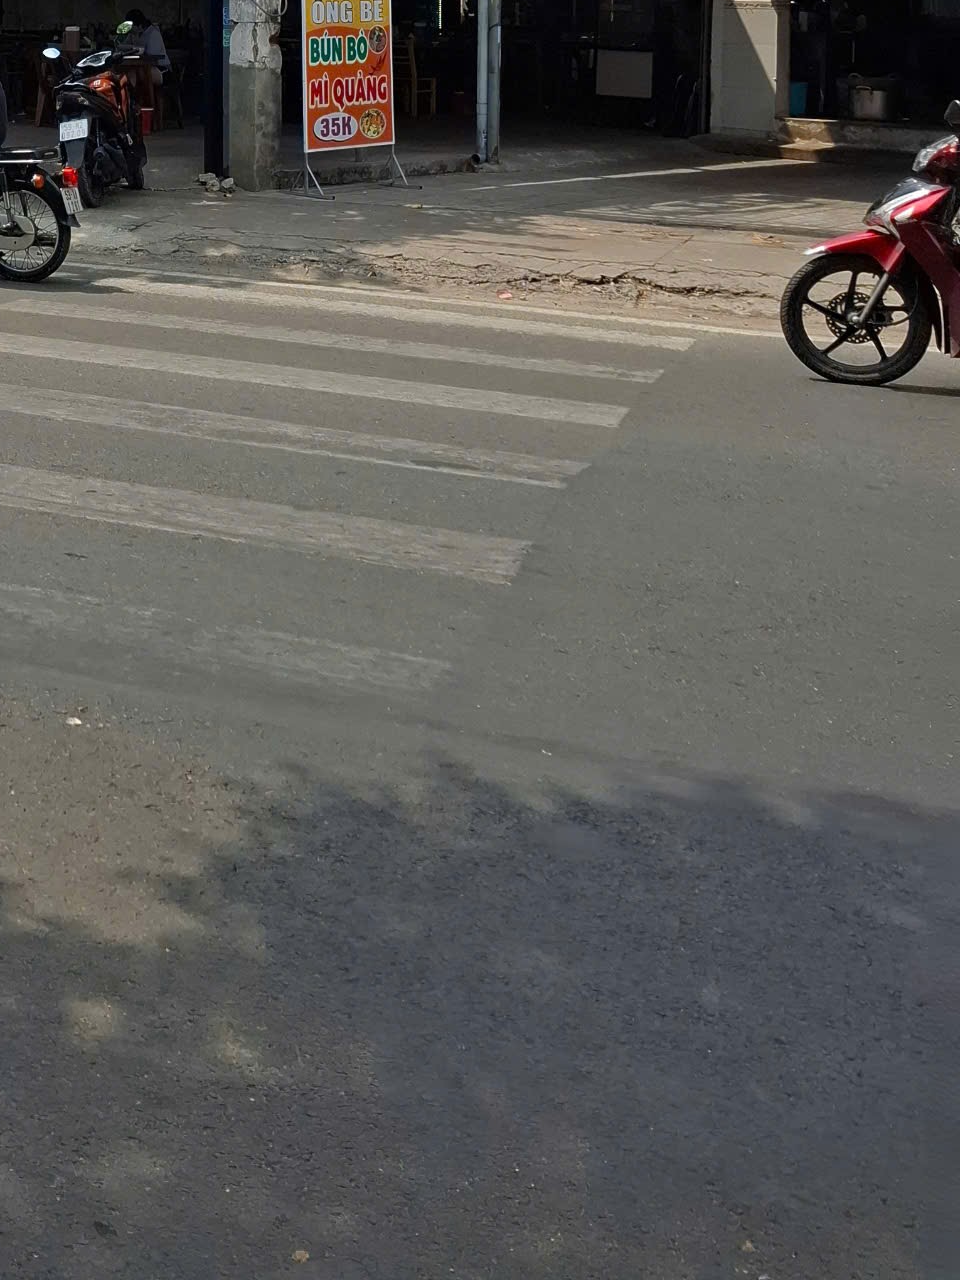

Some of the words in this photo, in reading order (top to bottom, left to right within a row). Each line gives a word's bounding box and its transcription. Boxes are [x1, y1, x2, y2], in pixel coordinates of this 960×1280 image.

[309, 29, 343, 65] BÚN
[347, 28, 368, 63] BÒ
[309, 72, 330, 109] MÌ
[332, 70, 388, 111] QUẢNG
[320, 116, 352, 138] 35K
